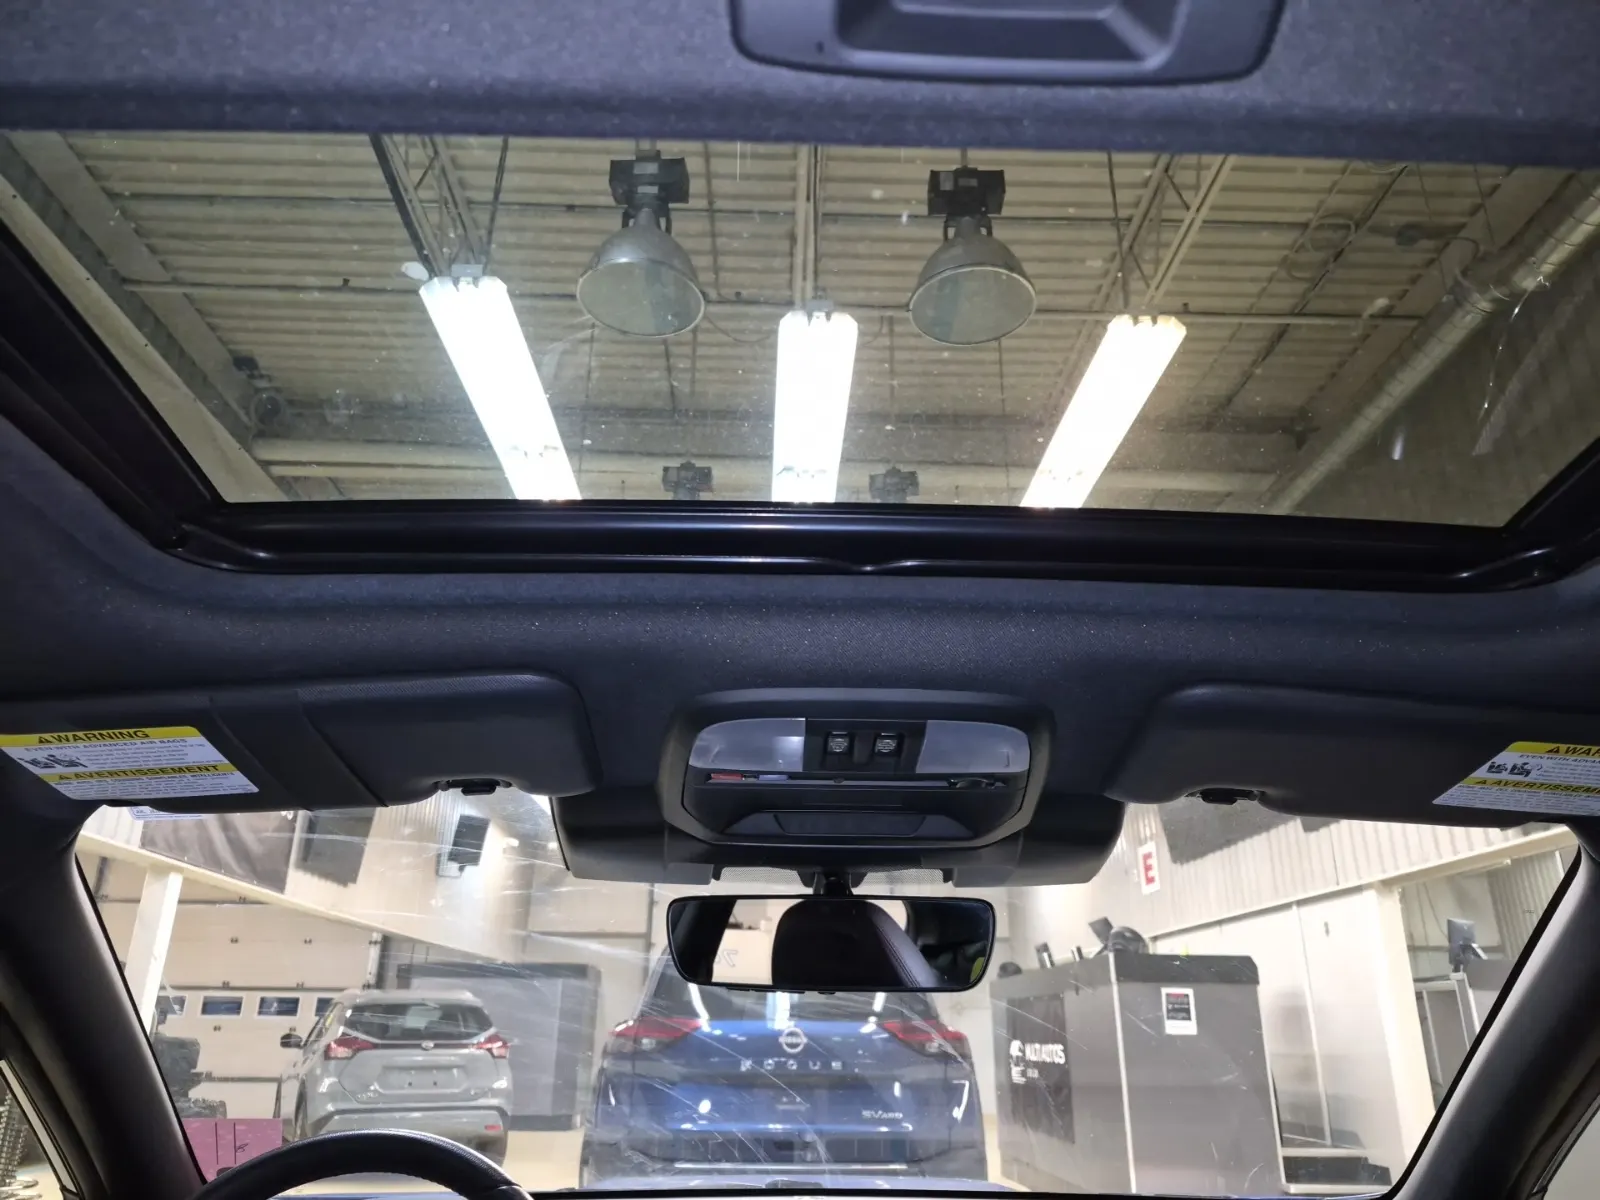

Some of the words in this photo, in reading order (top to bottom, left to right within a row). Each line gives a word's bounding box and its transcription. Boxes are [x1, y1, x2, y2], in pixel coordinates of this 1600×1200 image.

[51, 729, 151, 744] WARNING
[82, 741, 138, 749] ADVANCED
[74, 764, 219, 780] AVERTISSEMENT
[1142, 851, 1155, 886] E
